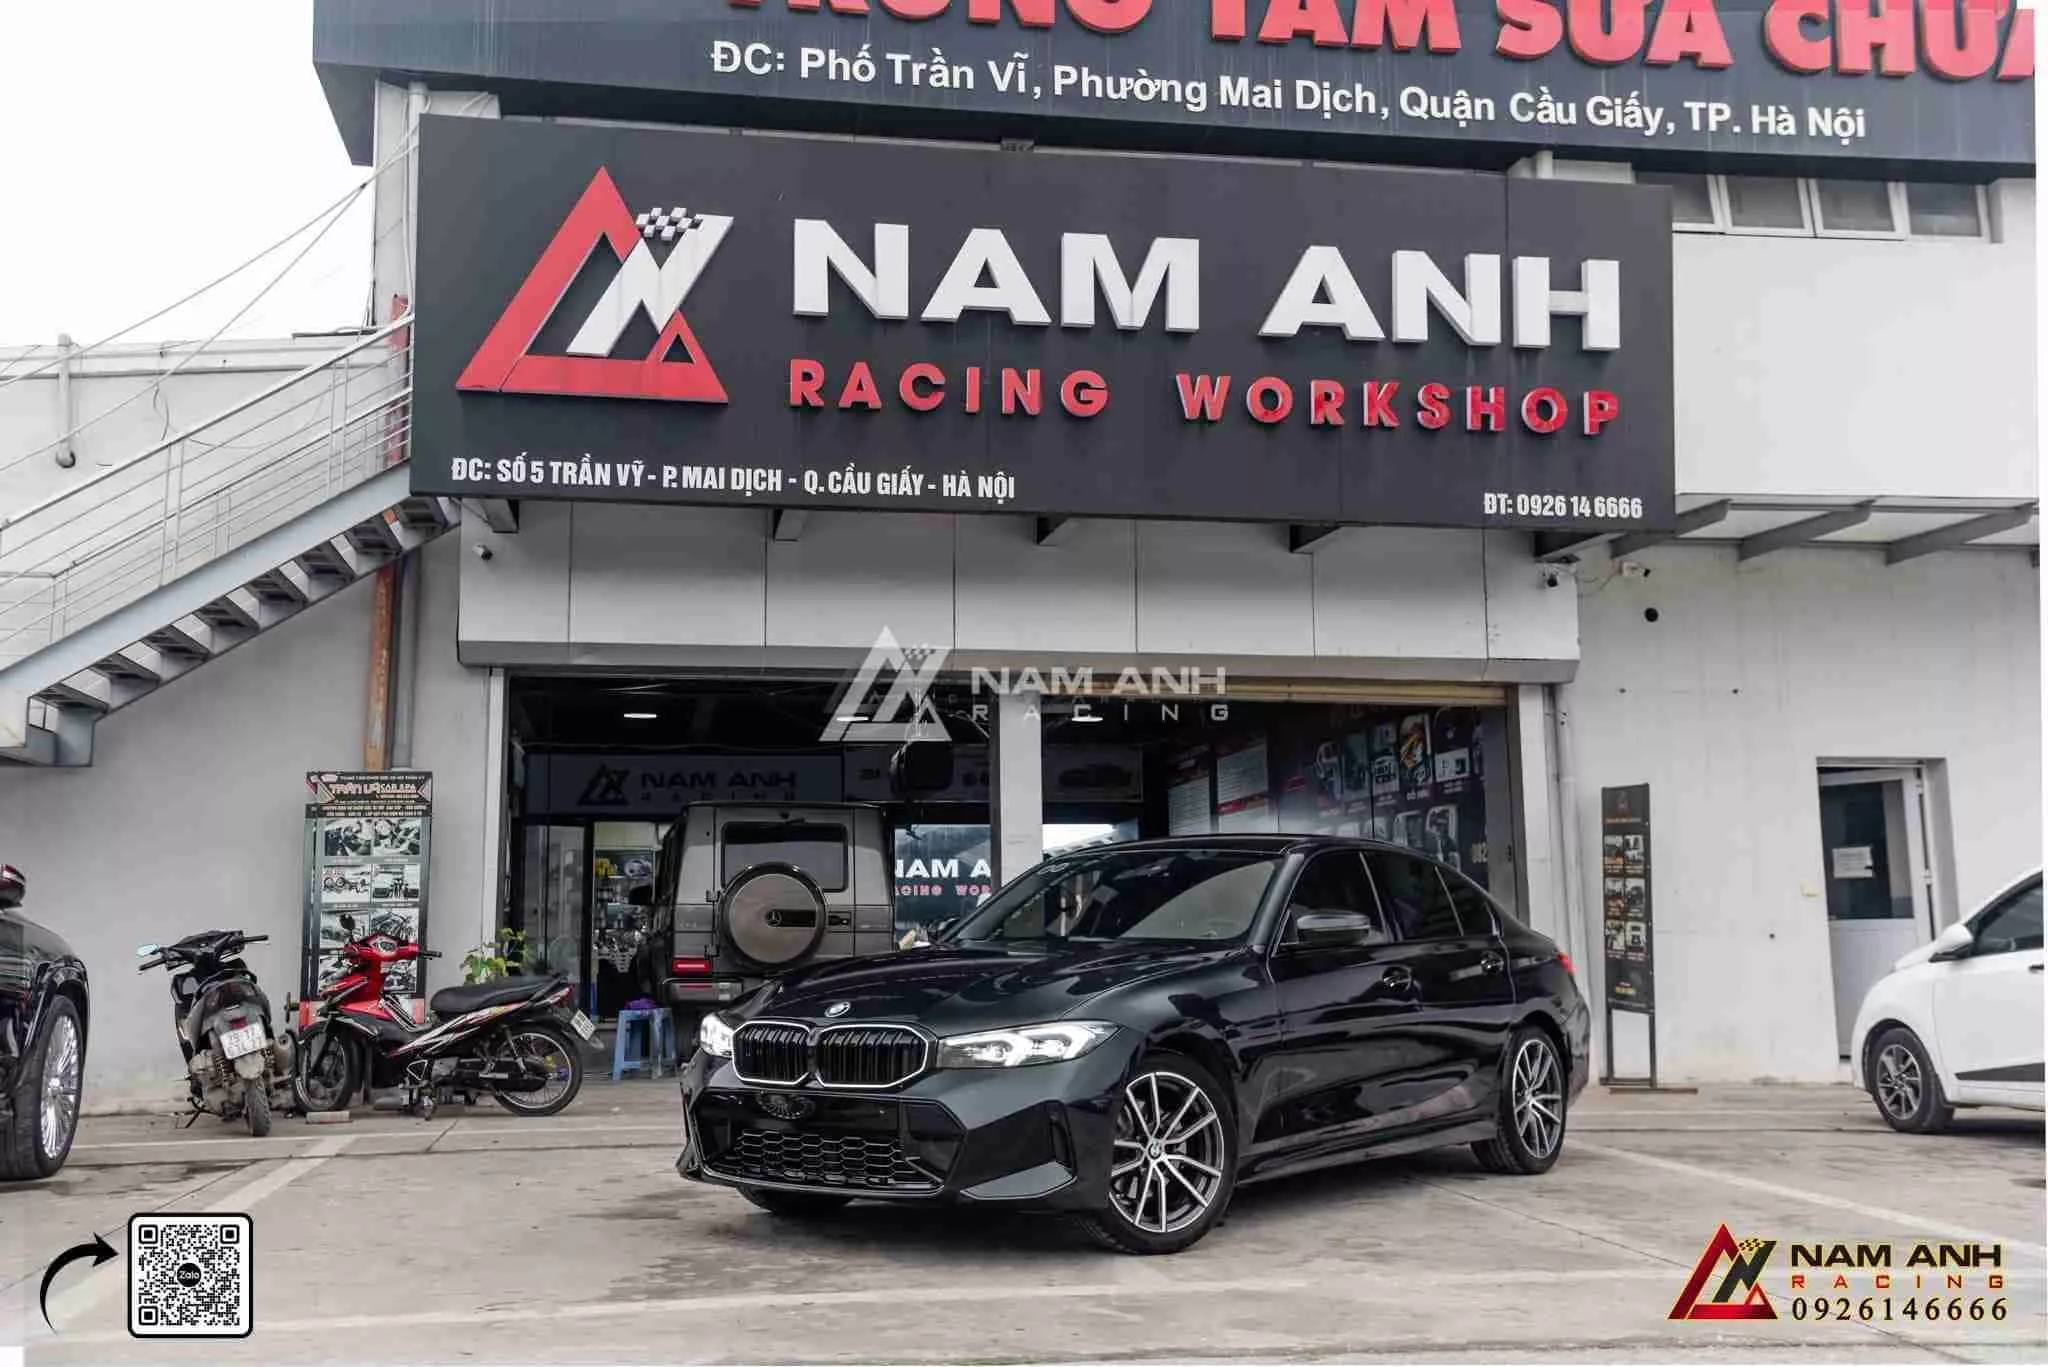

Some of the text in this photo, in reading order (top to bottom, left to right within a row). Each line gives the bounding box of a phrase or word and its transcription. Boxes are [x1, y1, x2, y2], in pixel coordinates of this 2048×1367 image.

[711, 40, 785, 75] ĐC:
[800, 44, 876, 82] Phố
[886, 47, 974, 90] Trần
[1053, 65, 1207, 111] Phường
[1219, 75, 1282, 109] Mai
[1295, 79, 1389, 120] Dịch,
[1400, 86, 1495, 127] Quận
[1509, 86, 1577, 125] Cầu
[1585, 91, 1675, 136] Giấy,
[1684, 101, 1740, 133] TP.
[1751, 104, 1796, 136] Hà
[1808, 106, 1866, 145] Nội
[793, 218, 1621, 351] NAM ANH
[789, 358, 1620, 435] RACING WORKSHOP
[451, 457, 491, 481] ĐC:
[496, 451, 527, 483] SỐ
[530, 461, 544, 482] 5
[549, 453, 610, 486] TRẦN
[616, 460, 645, 487] VỸ
[682, 467, 725, 489] MAI
[731, 467, 782, 496] DỊCH
[828, 462, 871, 494] CẦU
[877, 465, 924, 496] GIẤY
[943, 470, 972, 497] HÀ
[978, 471, 1015, 504] NỘI
[1484, 492, 1643, 519] ĐT: 0926 14 6666
[640, 771, 797, 788] NAM ANH
